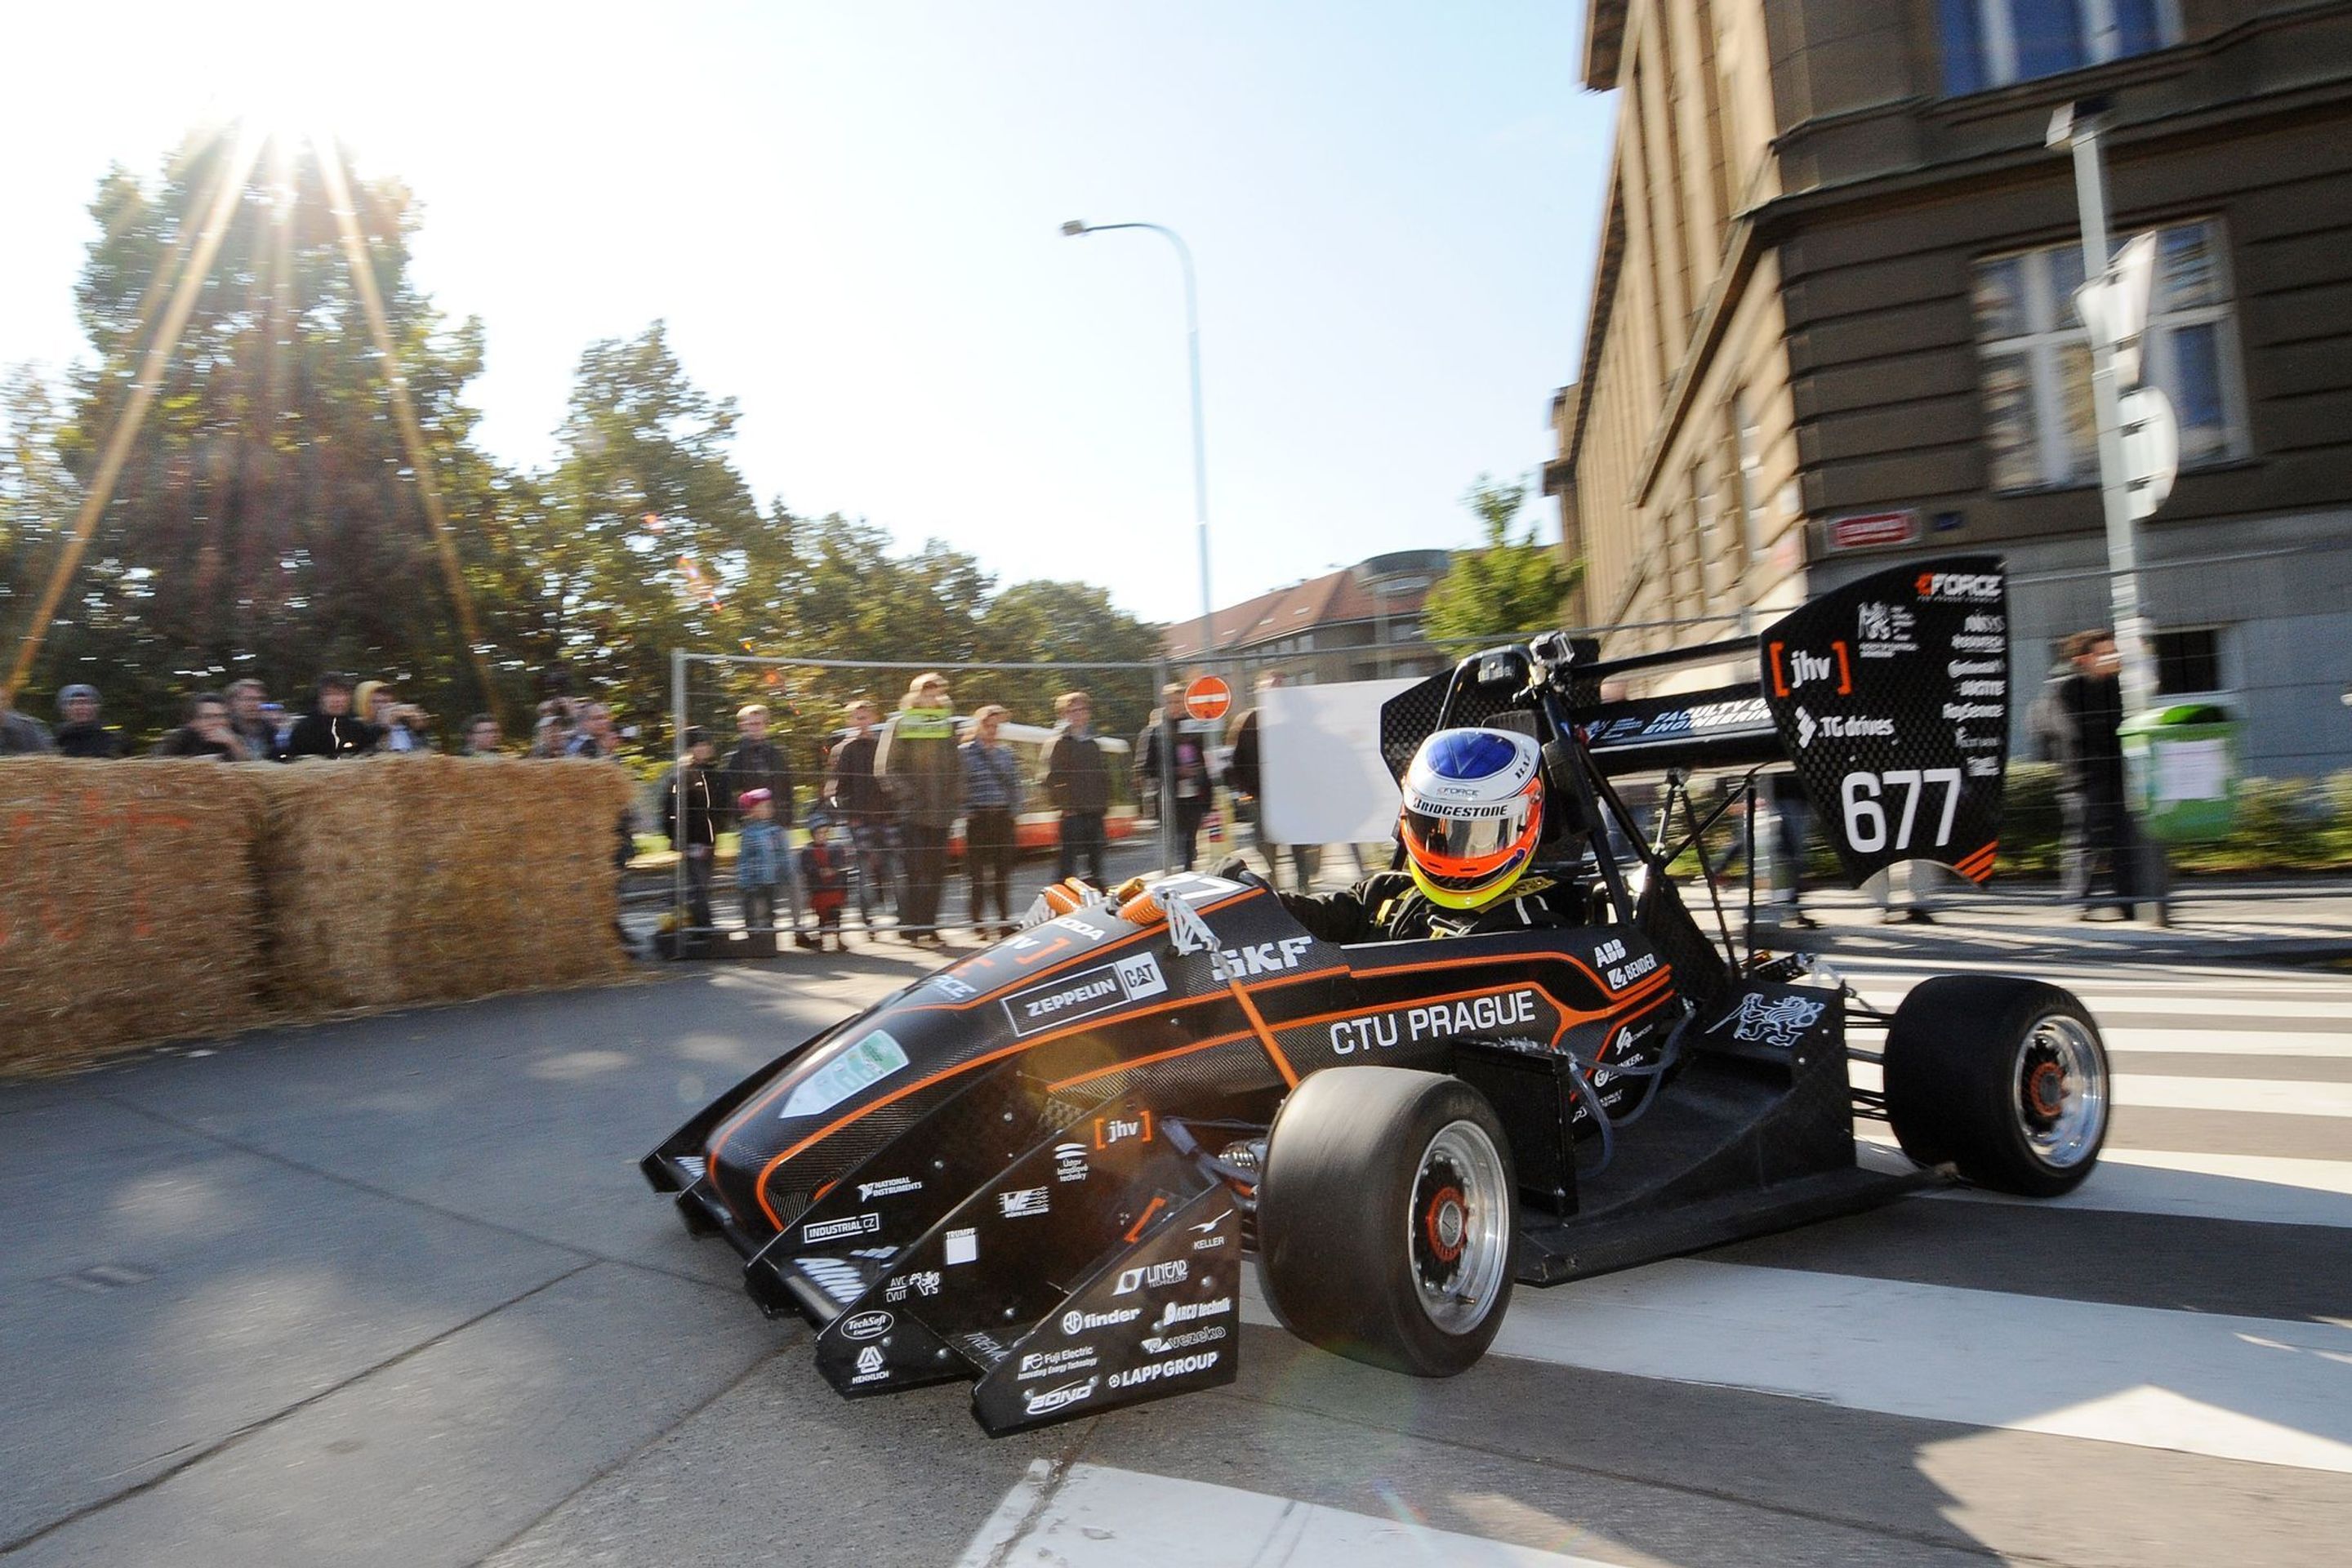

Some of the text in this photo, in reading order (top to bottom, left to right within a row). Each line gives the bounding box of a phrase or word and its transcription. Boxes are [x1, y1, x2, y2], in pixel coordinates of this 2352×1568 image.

[1642, 708, 1772, 735] ENGINEERIN
[1413, 798, 1509, 817] BRIDGESTONE
[1841, 768, 1961, 853] 677
[1209, 936, 1313, 981] SKF
[1594, 938, 1626, 968] ABB
[1124, 964, 1155, 988] CAT
[1624, 953, 1658, 980] BENDER
[1025, 978, 1117, 1018] ZEPPELIN
[1330, 991, 1535, 1055] CTU PRAGUE
[873, 1176, 911, 1188] NATIONAL
[873, 1181, 923, 1197] INSTRUMENTS
[809, 1218, 875, 1238] INDUSTRIAL CZ
[946, 1227, 976, 1240] TRUMPF
[1193, 1236, 1225, 1250] KELLER
[890, 1275, 906, 1288] AVC
[1147, 1259, 1189, 1283] LINEAR
[848, 1315, 887, 1330] TechSoft
[1084, 1308, 1142, 1329] finder
[1168, 1325, 1227, 1348] vezeko
[1045, 1352, 1061, 1365] Fuji
[1062, 1346, 1094, 1361] Electric
[852, 1370, 889, 1384] HENNLICH
